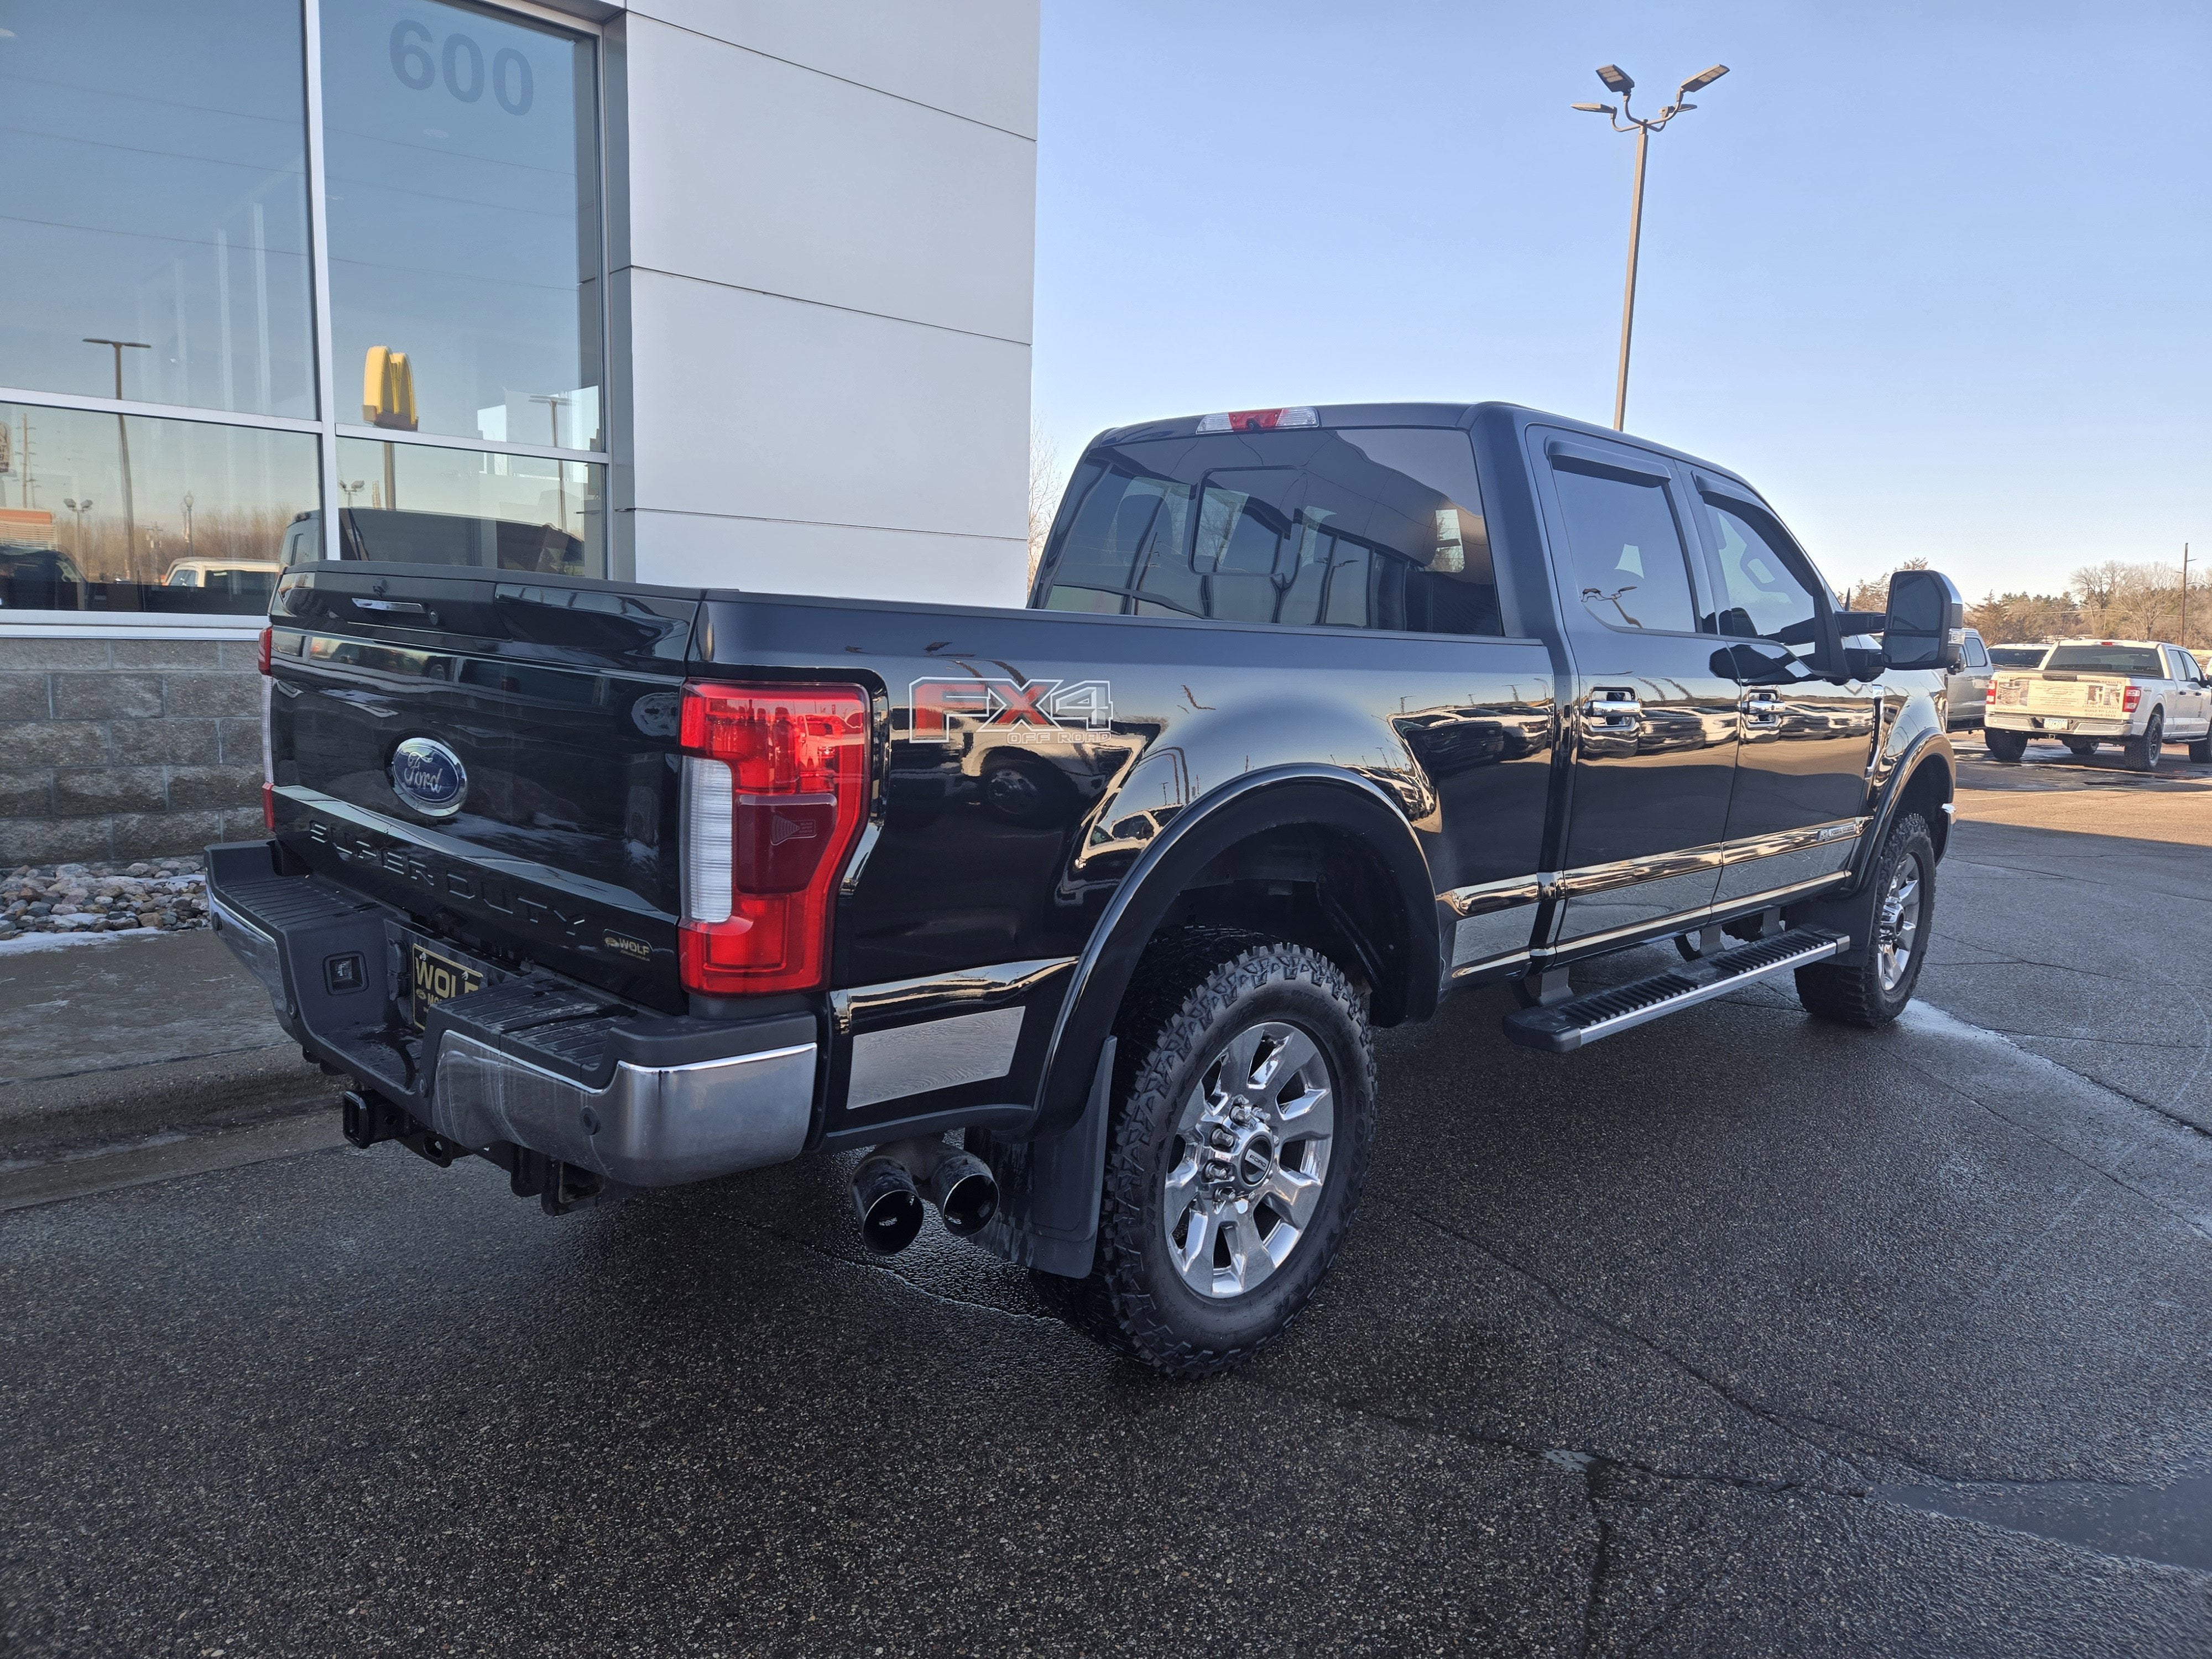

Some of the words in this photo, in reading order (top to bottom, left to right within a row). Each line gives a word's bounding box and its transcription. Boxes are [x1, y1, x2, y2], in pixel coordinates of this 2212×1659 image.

[389, 20, 534, 116] 600
[909, 676, 1113, 743] FX4
[1007, 732, 1051, 744] OFF
[1057, 732, 1112, 744] ROAD
[404, 751, 443, 794] Ford
[309, 820, 435, 886] SUPER
[446, 872, 585, 936] DUTY
[619, 938, 650, 956] WOLF
[1249, 1154, 1266, 1167] FORD
